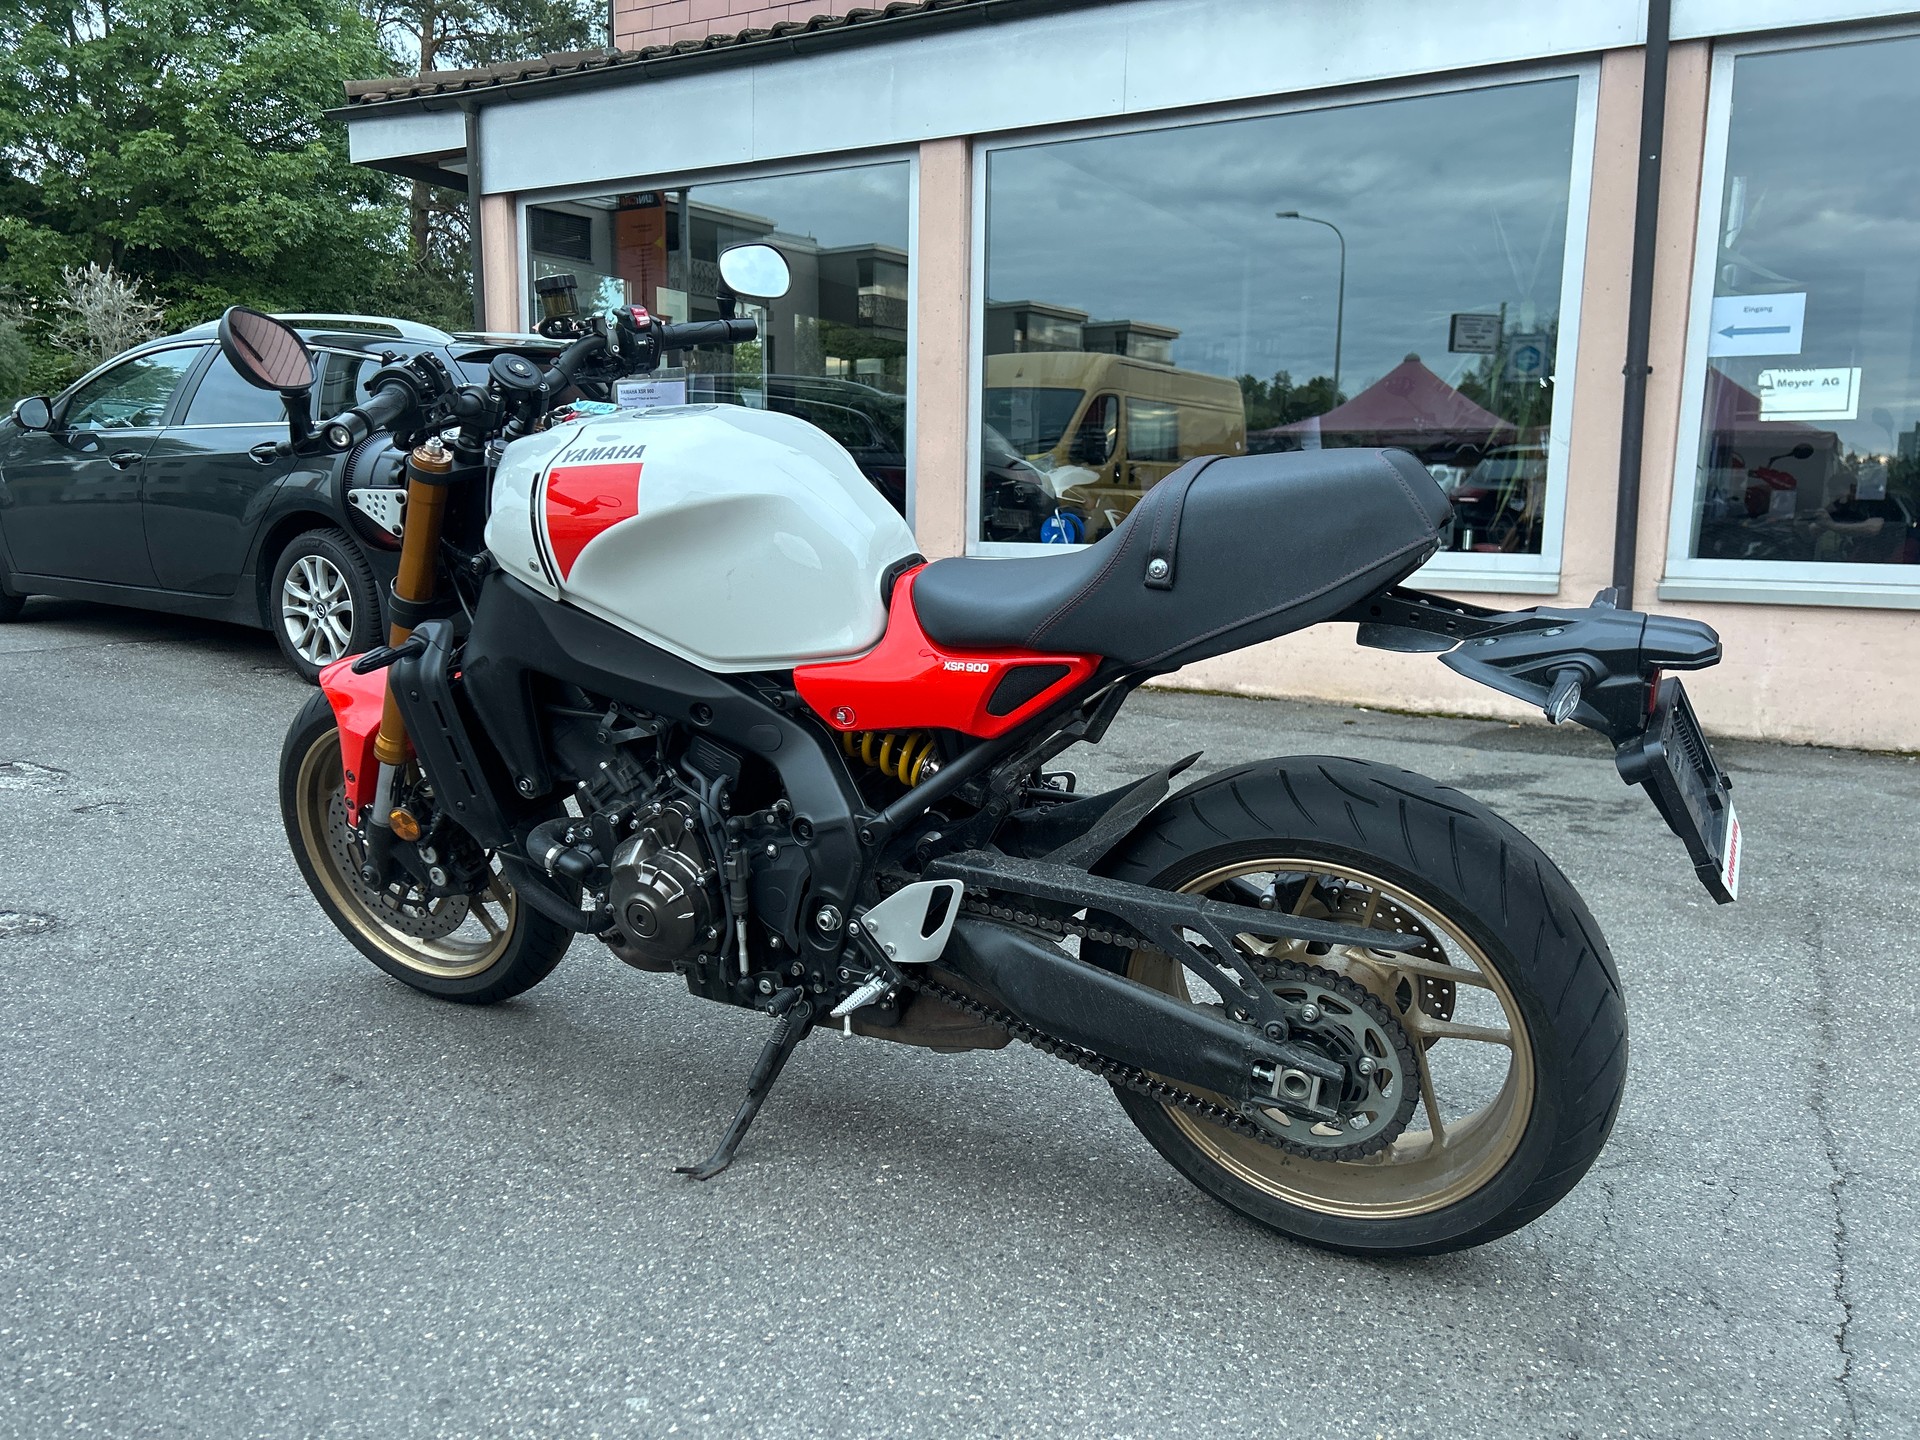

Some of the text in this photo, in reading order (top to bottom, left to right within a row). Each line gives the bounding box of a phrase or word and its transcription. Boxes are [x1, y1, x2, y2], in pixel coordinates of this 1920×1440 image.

[1743, 305, 1773, 313] Eingang
[1777, 377, 1840, 389] Meyer AG
[561, 444, 647, 463] YAMAHA
[943, 661, 989, 673] XSR 900
